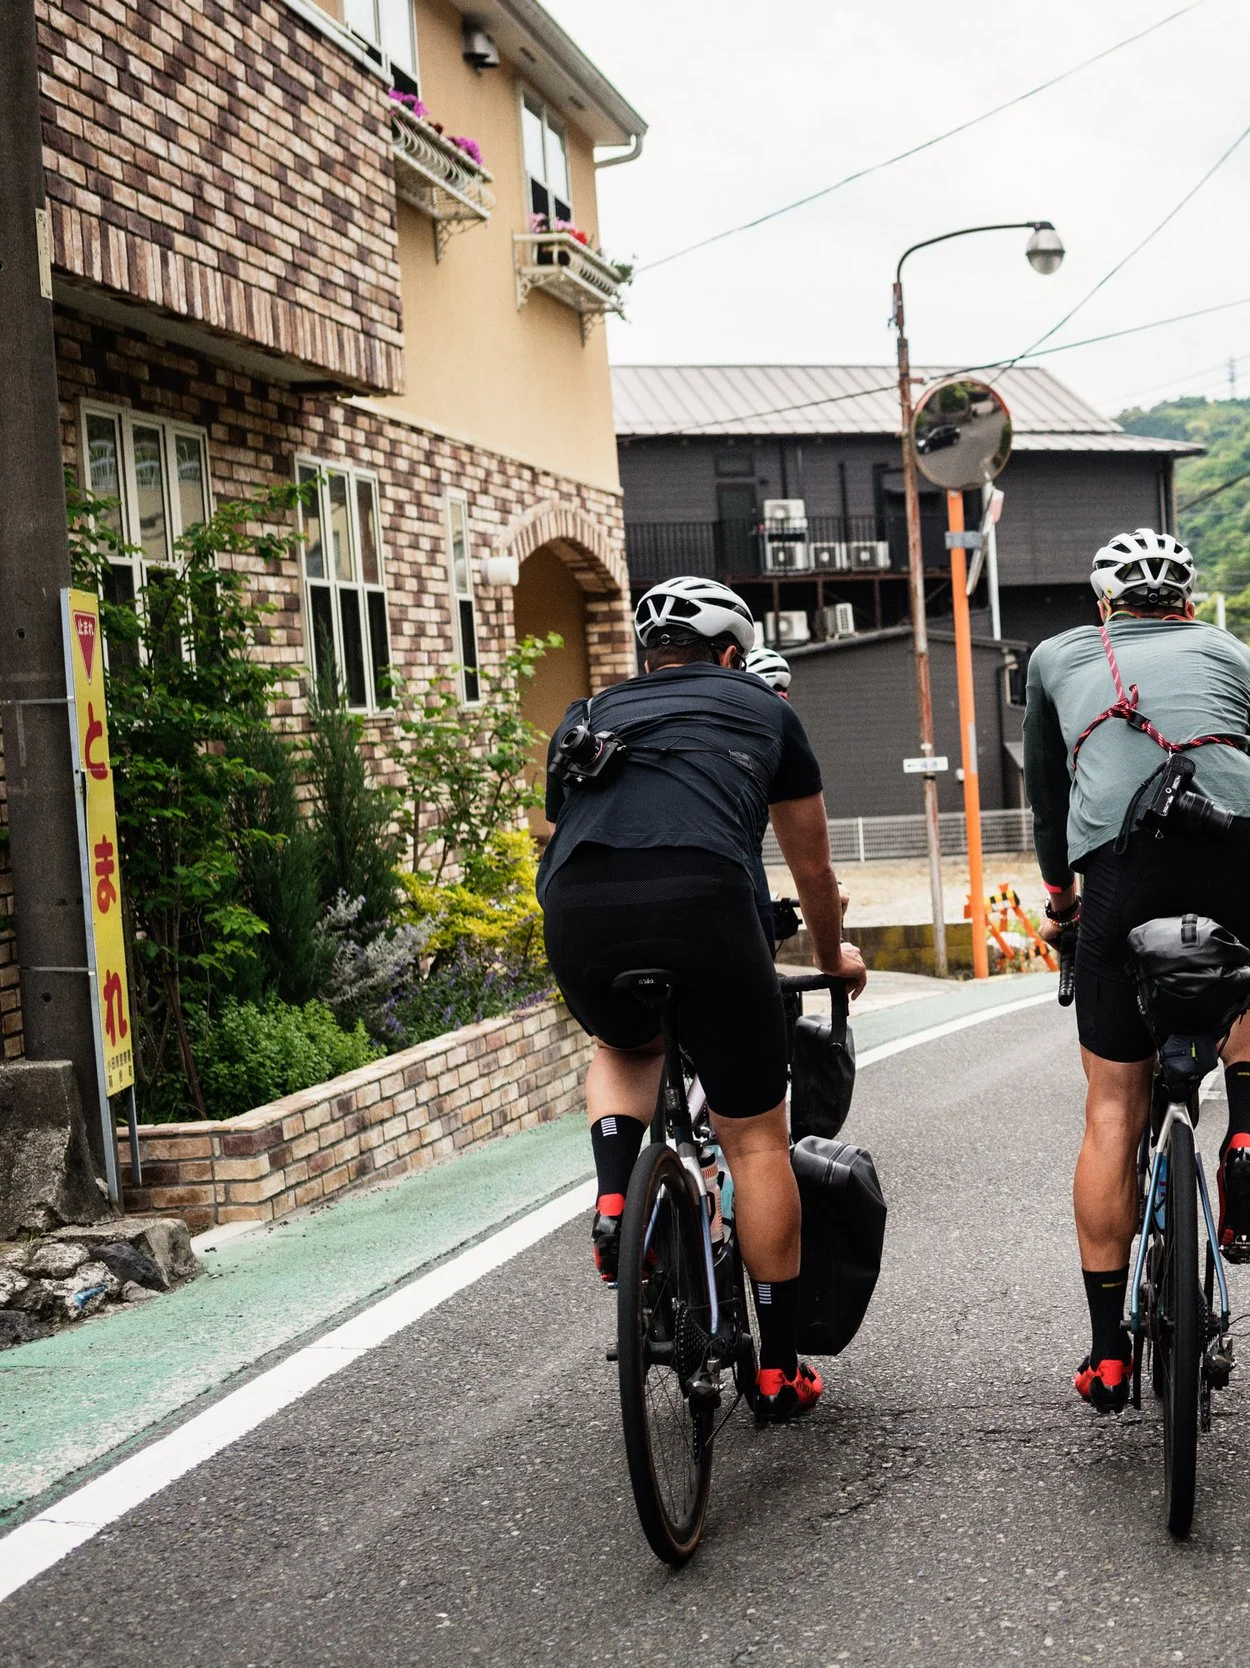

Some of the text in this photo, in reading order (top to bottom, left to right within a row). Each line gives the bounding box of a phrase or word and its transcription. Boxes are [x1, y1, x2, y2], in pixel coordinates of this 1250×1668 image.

[77, 617, 95, 637] 止まれ
[84, 701, 128, 1047] とまれ
